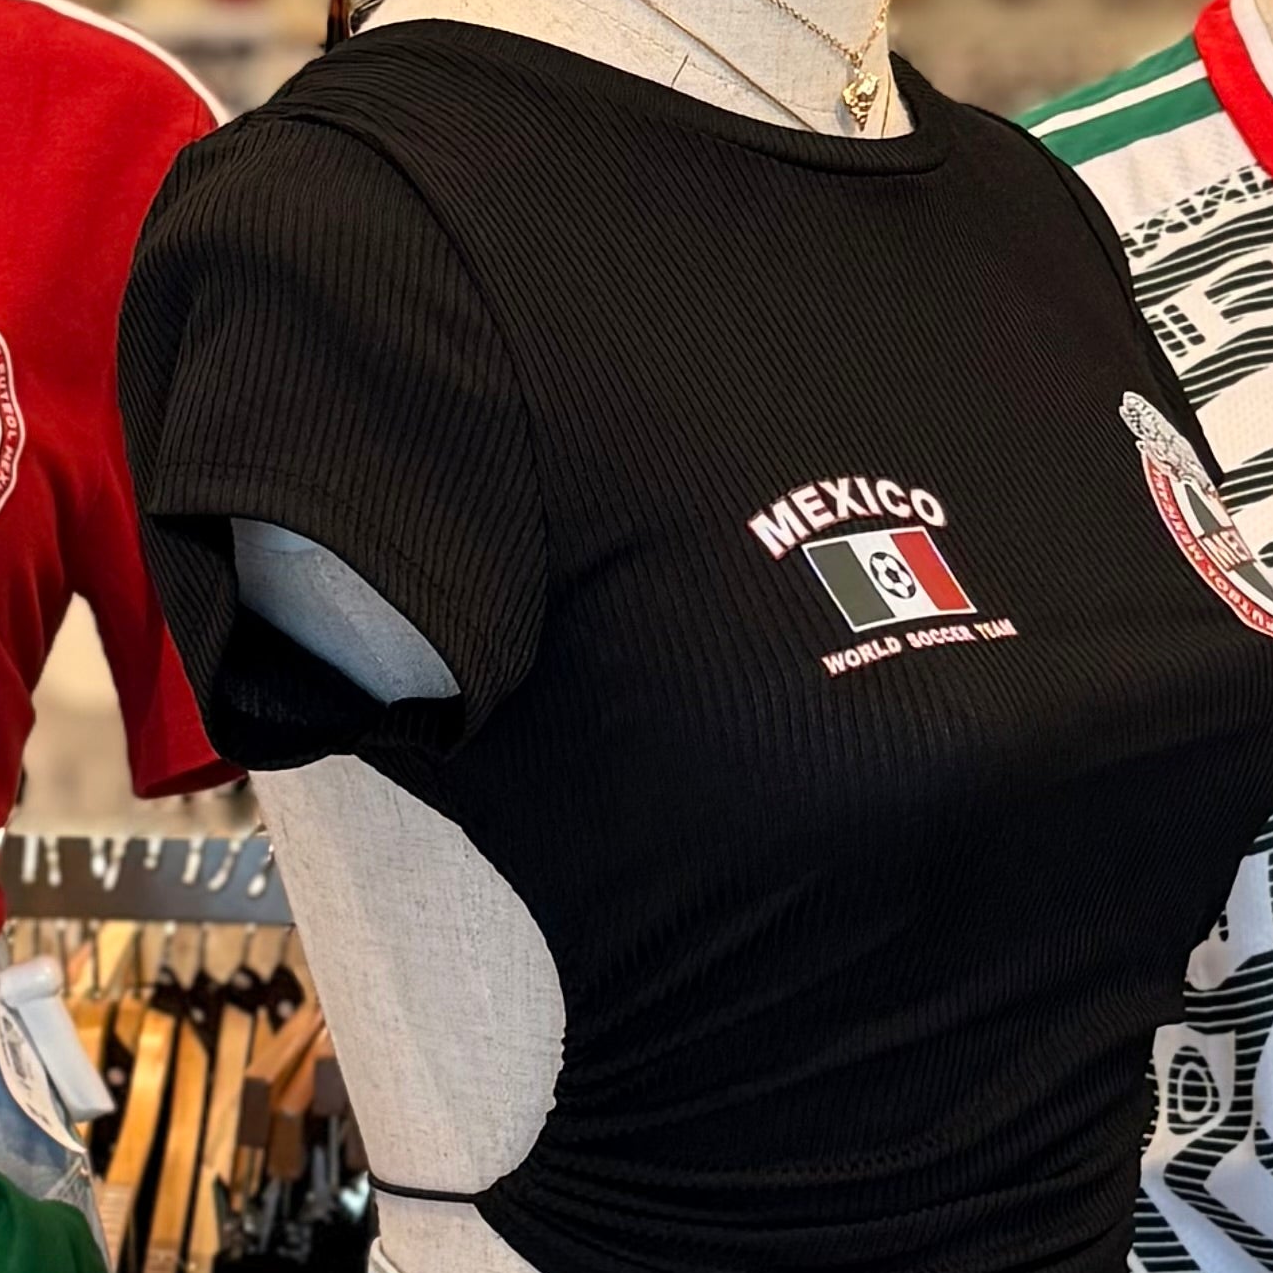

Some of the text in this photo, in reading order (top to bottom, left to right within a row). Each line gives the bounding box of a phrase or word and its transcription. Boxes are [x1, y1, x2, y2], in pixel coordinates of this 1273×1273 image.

[747, 476, 948, 561] MEXICO
[822, 618, 1018, 677] WORLD SOCCER TEAM
